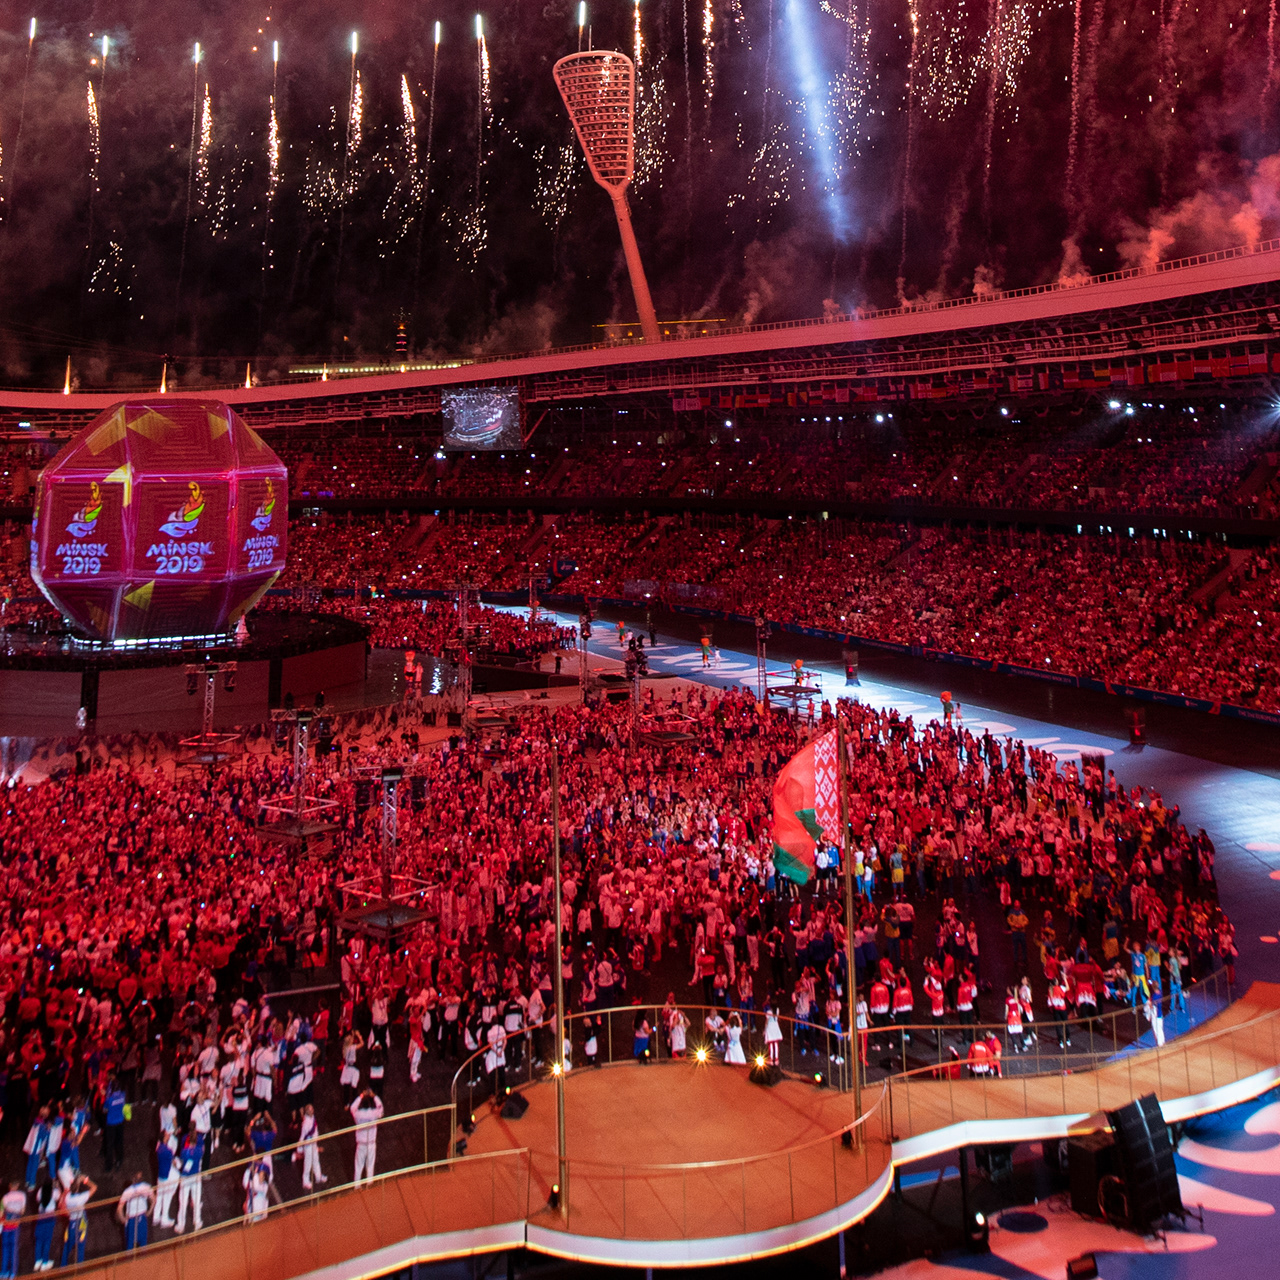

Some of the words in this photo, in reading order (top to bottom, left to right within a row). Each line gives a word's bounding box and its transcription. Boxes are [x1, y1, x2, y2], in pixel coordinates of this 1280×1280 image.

[62, 556, 101, 574] 2019
[155, 556, 206, 575] 2019
[248, 548, 274, 568] 2019
